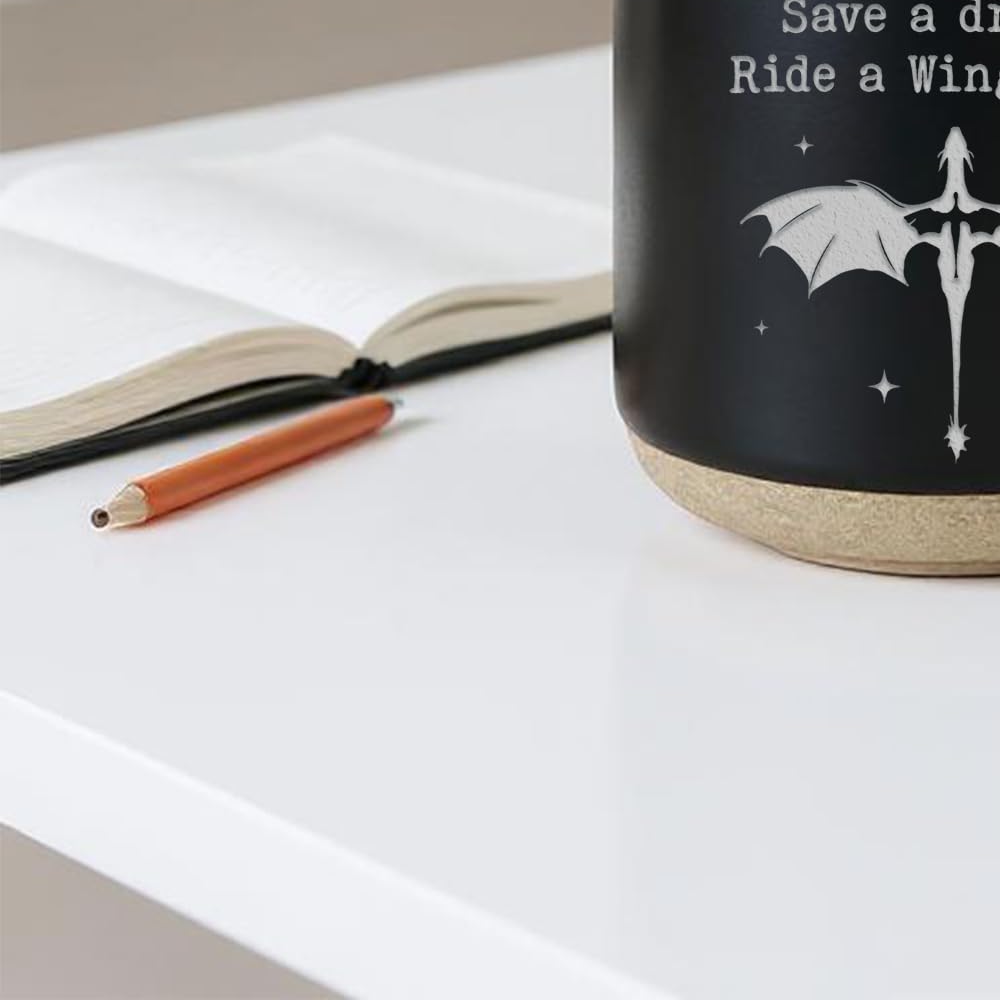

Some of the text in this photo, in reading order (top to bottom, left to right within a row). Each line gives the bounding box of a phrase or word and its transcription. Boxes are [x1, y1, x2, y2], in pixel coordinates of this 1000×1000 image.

[910, 3, 937, 33] a
[729, 53, 836, 94] Ride
[859, 63, 886, 93] a
